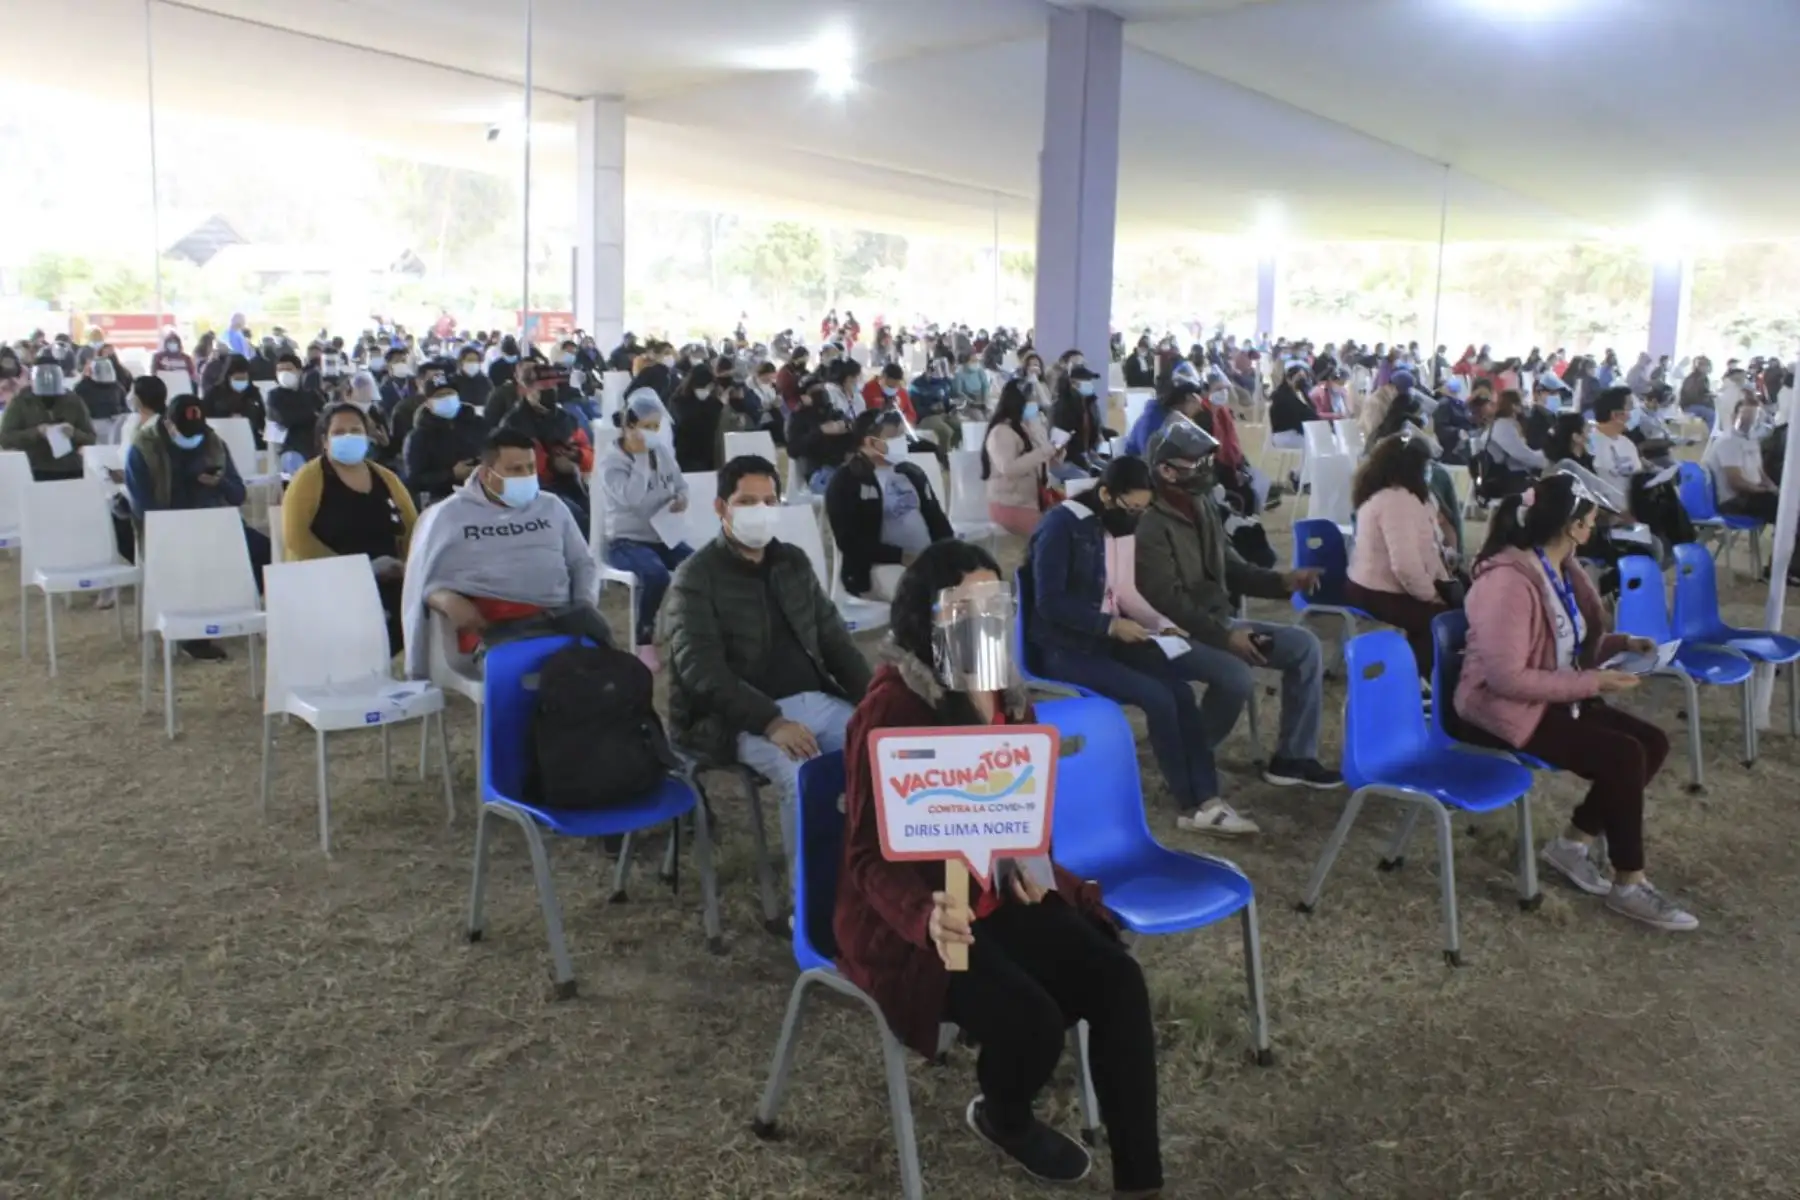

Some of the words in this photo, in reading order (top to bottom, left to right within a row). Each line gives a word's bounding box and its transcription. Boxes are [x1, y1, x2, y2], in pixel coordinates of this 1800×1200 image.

[463, 518, 551, 540] Reebok
[928, 804, 971, 814] CONTRA
[973, 803, 986, 813] LA
[988, 802, 1035, 813] COVID-19
[904, 824, 940, 837] DIRIS
[944, 823, 980, 836] LIMA
[983, 821, 1031, 835] NORTE
